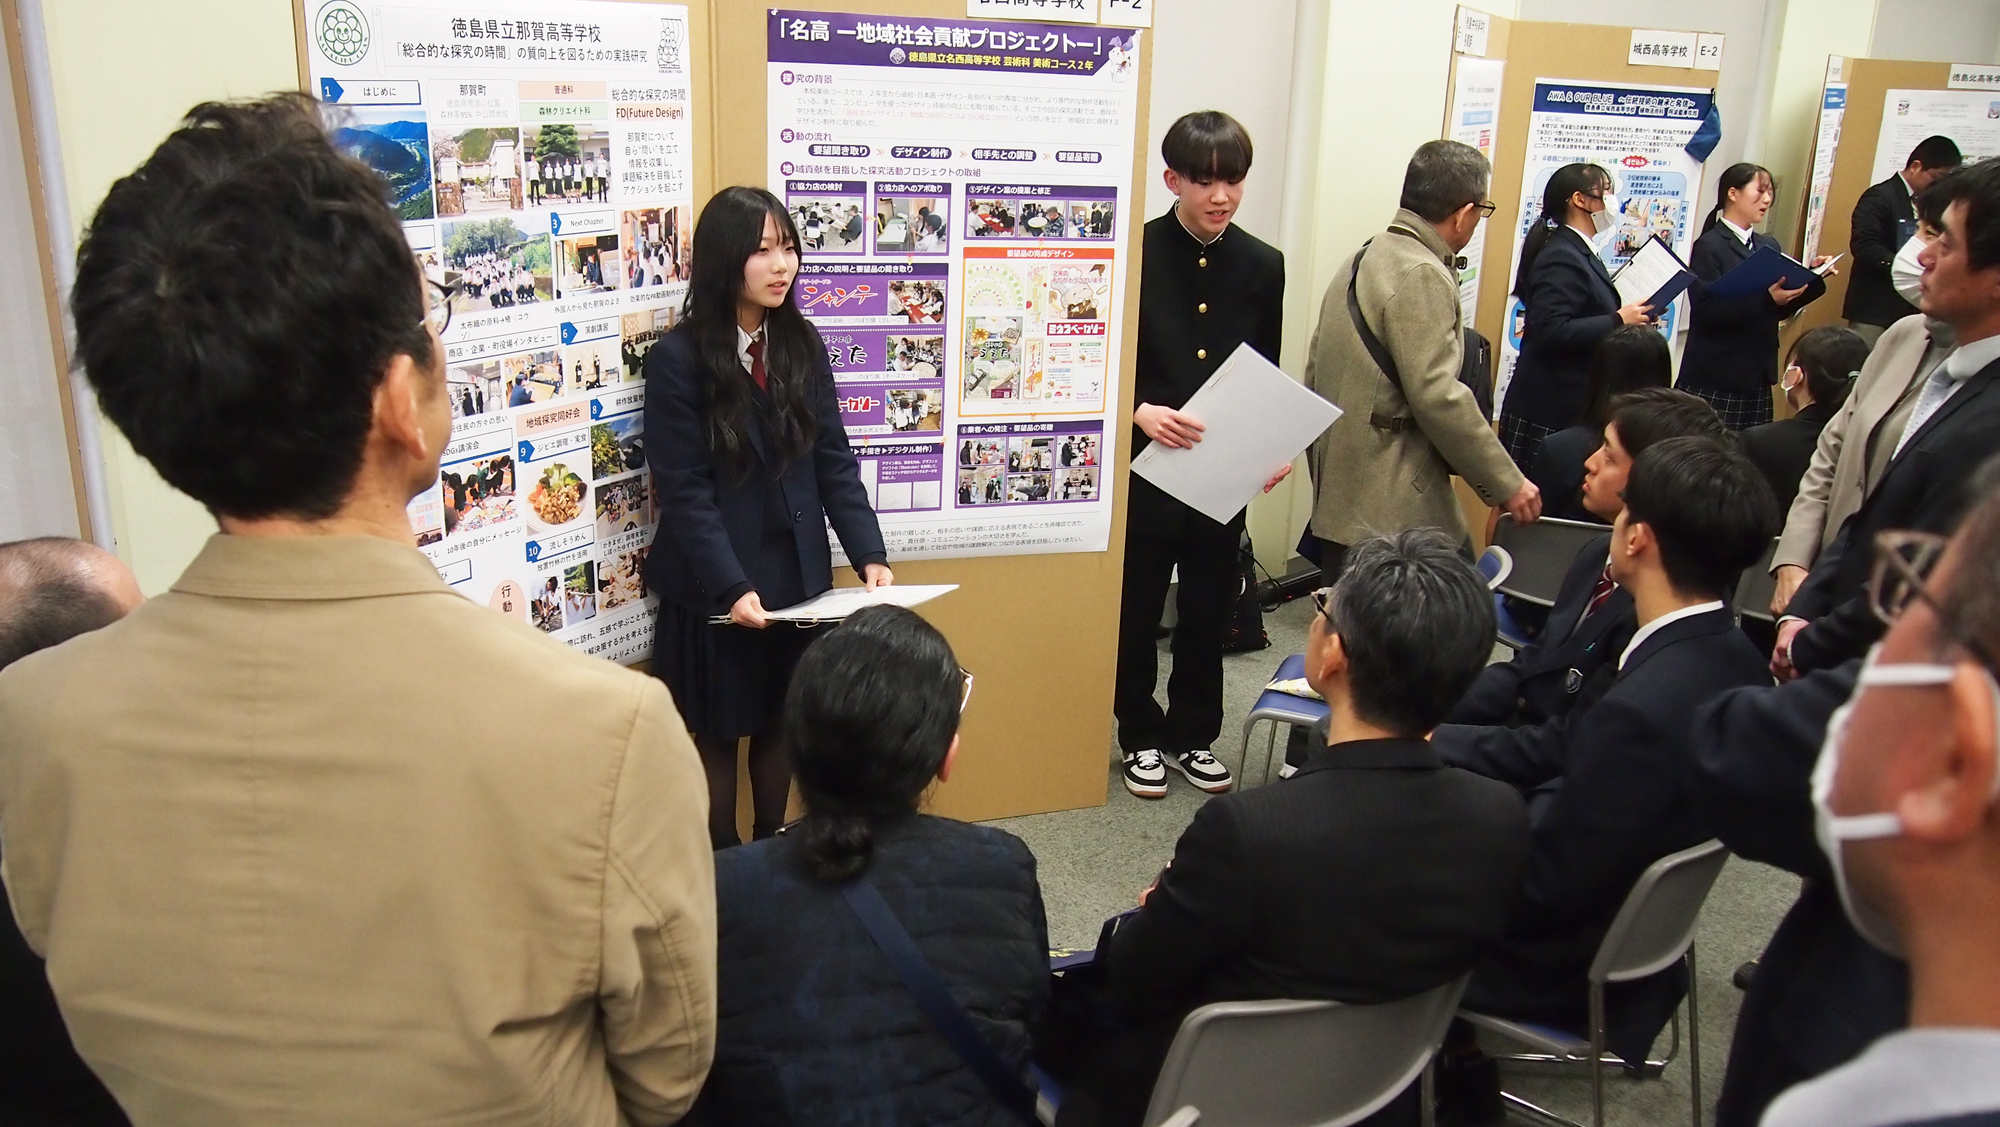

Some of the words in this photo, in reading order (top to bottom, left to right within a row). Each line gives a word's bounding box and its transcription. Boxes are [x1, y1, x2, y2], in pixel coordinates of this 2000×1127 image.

[980, 0, 1084, 10] 高等学校
[451, 18, 601, 43] 徳島県立那賀高等学校
[780, 18, 830, 42] 「名高
[396, 41, 648, 63] 「総合的な探究の時間」の質向上を図るための実践研究
[1632, 43, 1688, 58] 城西高等学校
[1700, 45, 1718, 57] E-2
[908, 52, 1001, 66] 徳島県立名西高等学校
[1003, 55, 1030, 68] 芸術科
[781, 71, 833, 85] 探究の背景
[324, 86, 331, 97] 1
[363, 87, 396, 97] はじめに
[459, 84, 486, 96] 那賀町
[554, 85, 574, 95] 普通科
[612, 88, 686, 101] 総合的な探究の時間
[1548, 92, 1565, 101] AWA
[1566, 92, 1573, 102] &
[1574, 93, 1591, 102] OUR
[1592, 94, 1613, 104] BLUE
[539, 106, 590, 116] 森林クリエイト科
[616, 107, 653, 120] FD(Future
[655, 107, 684, 120] Design)
[627, 131, 675, 143] 那賀町について
[781, 129, 833, 142] 活動の流れ
[813, 145, 869, 156] 要望聞き取り
[895, 147, 949, 158] デザイン制作
[974, 149, 1035, 161] 相手先との調整
[628, 157, 673, 169] 情報を収集し、
[622, 169, 683, 182] 課題解決を目指して
[781, 162, 981, 178] 地域貢献を目指した探究活動プロジェクトの取組
[623, 182, 684, 196] アクションを起こす
[552, 219, 558, 229] 3
[583, 218, 604, 226] Chapter
[554, 297, 620, 314] 外国人から見た那賀のよさ
[562, 328, 568, 339] 6
[584, 323, 609, 335] 演劇講習
[448, 335, 553, 358] 商店・企業・町役場インタビュー
[592, 405, 598, 415] 8
[526, 407, 581, 429] 地域探究同好会
[520, 447, 526, 457] 9
[549, 532, 587, 551] 流しそうめん
[528, 546, 538, 557] 10
[501, 584, 513, 614] 行動
